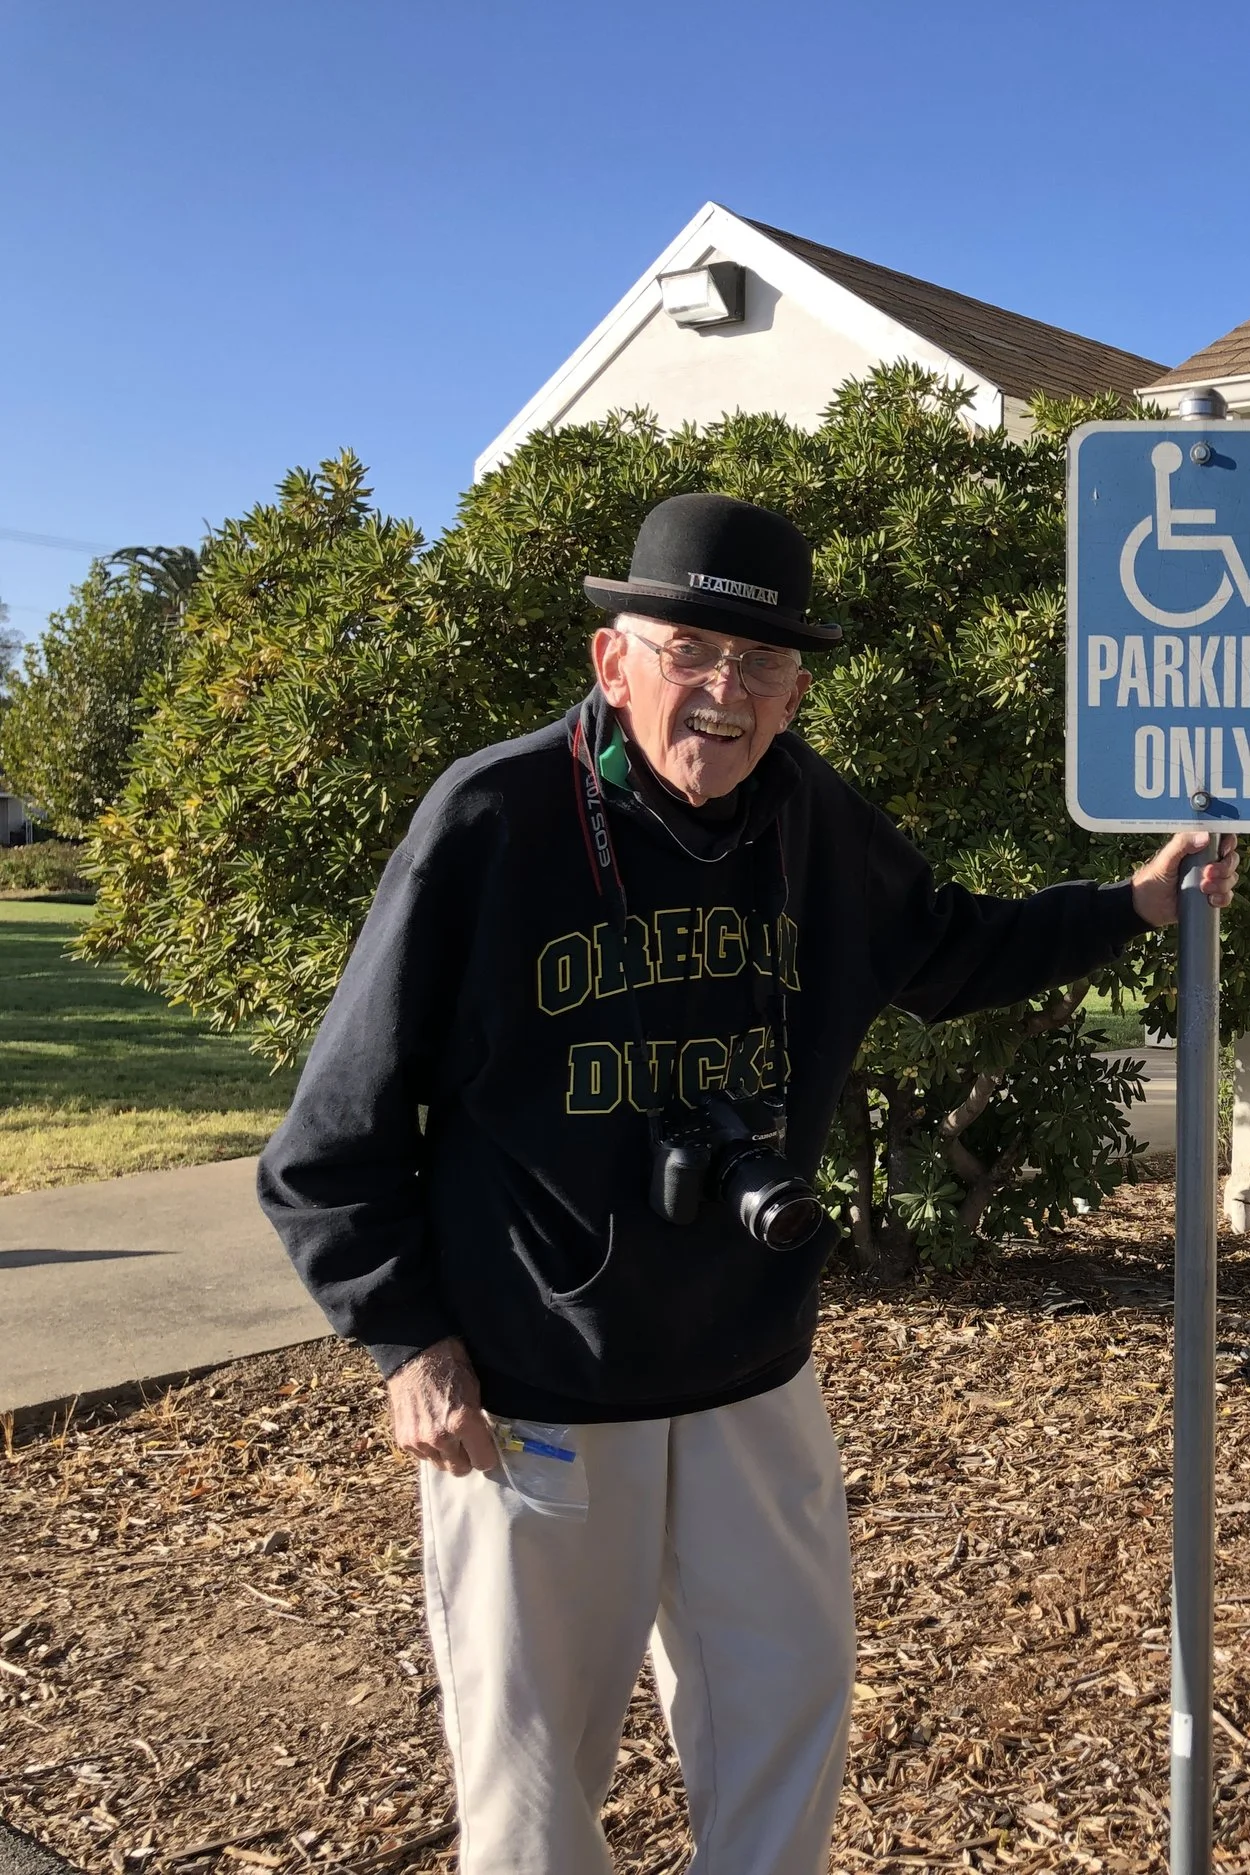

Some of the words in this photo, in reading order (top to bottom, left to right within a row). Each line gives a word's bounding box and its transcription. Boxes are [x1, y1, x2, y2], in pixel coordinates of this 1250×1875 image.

[687, 571, 779, 606] TRAINMAN
[590, 812, 611, 868] EOS
[537, 906, 802, 1016] OREGON
[565, 1025, 793, 1115] DUCKS
[752, 1131, 778, 1141] Canon
